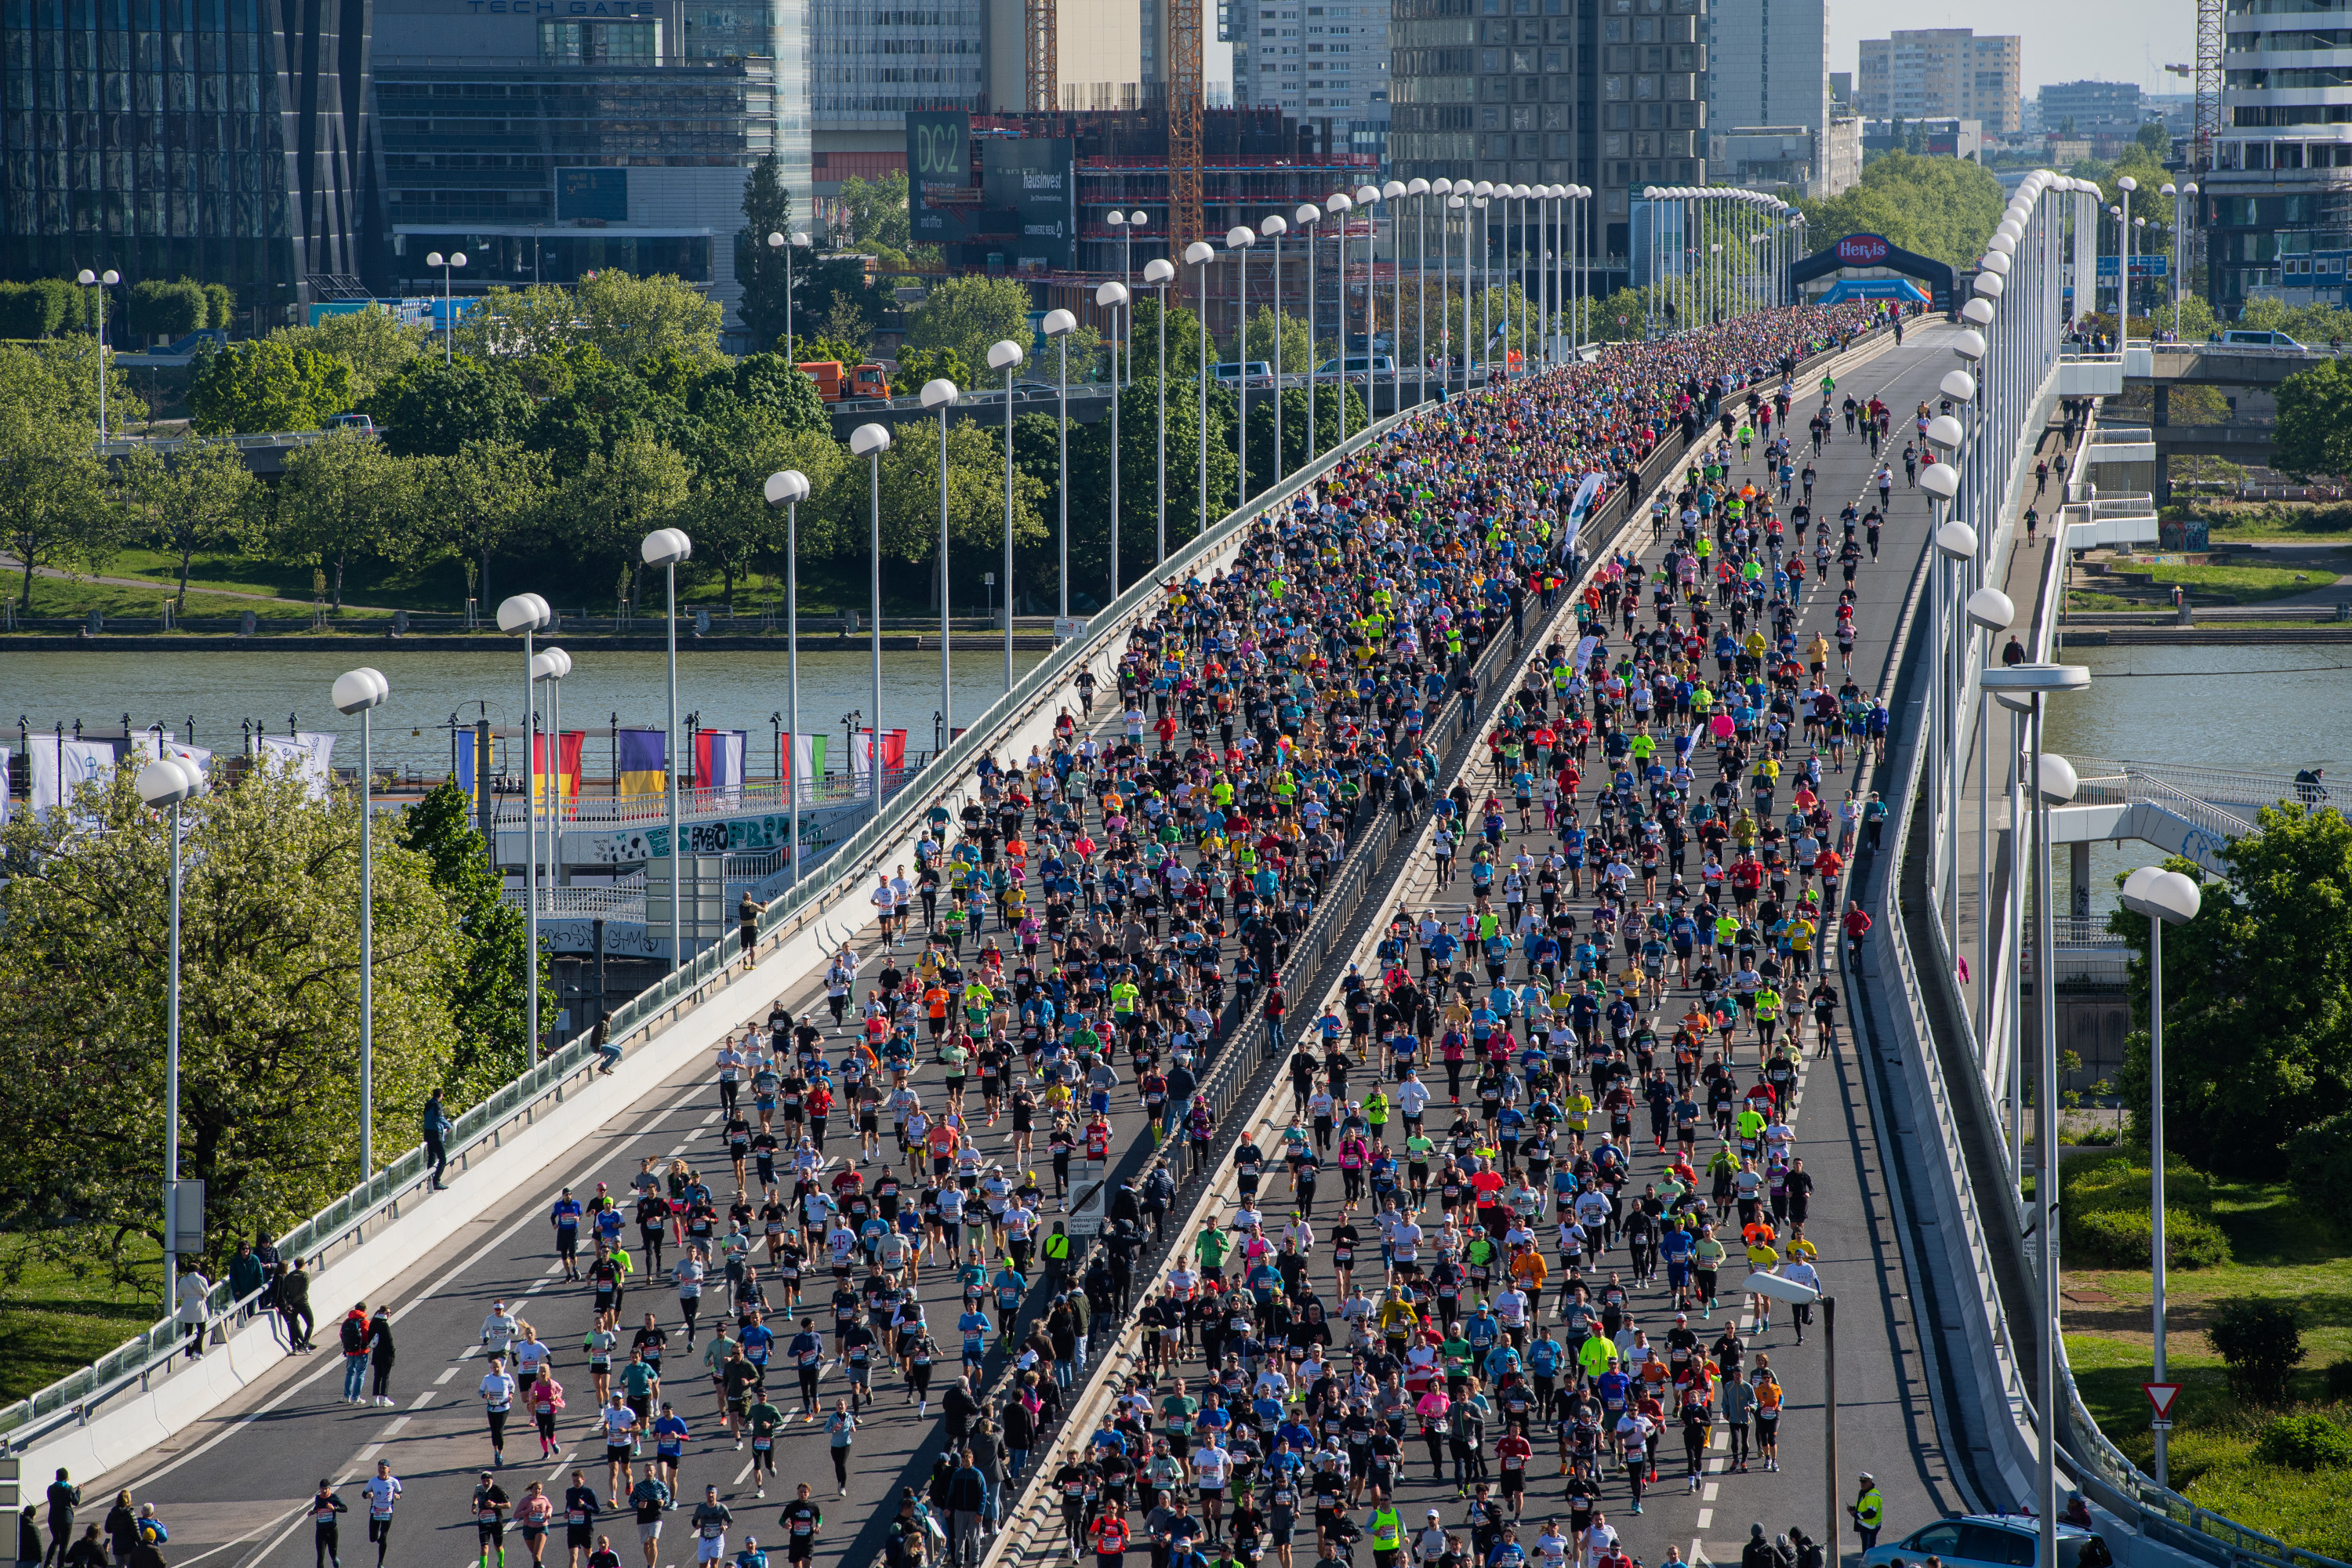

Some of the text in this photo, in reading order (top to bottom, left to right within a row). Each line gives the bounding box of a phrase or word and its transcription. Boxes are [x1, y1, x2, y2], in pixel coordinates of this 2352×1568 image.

[468, 1, 654, 14] TECH GATE
[918, 124, 958, 172] DC2
[930, 216, 942, 228] office
[1025, 225, 1056, 235] COMMERZ REAL
[1840, 241, 1886, 259] Hervis
